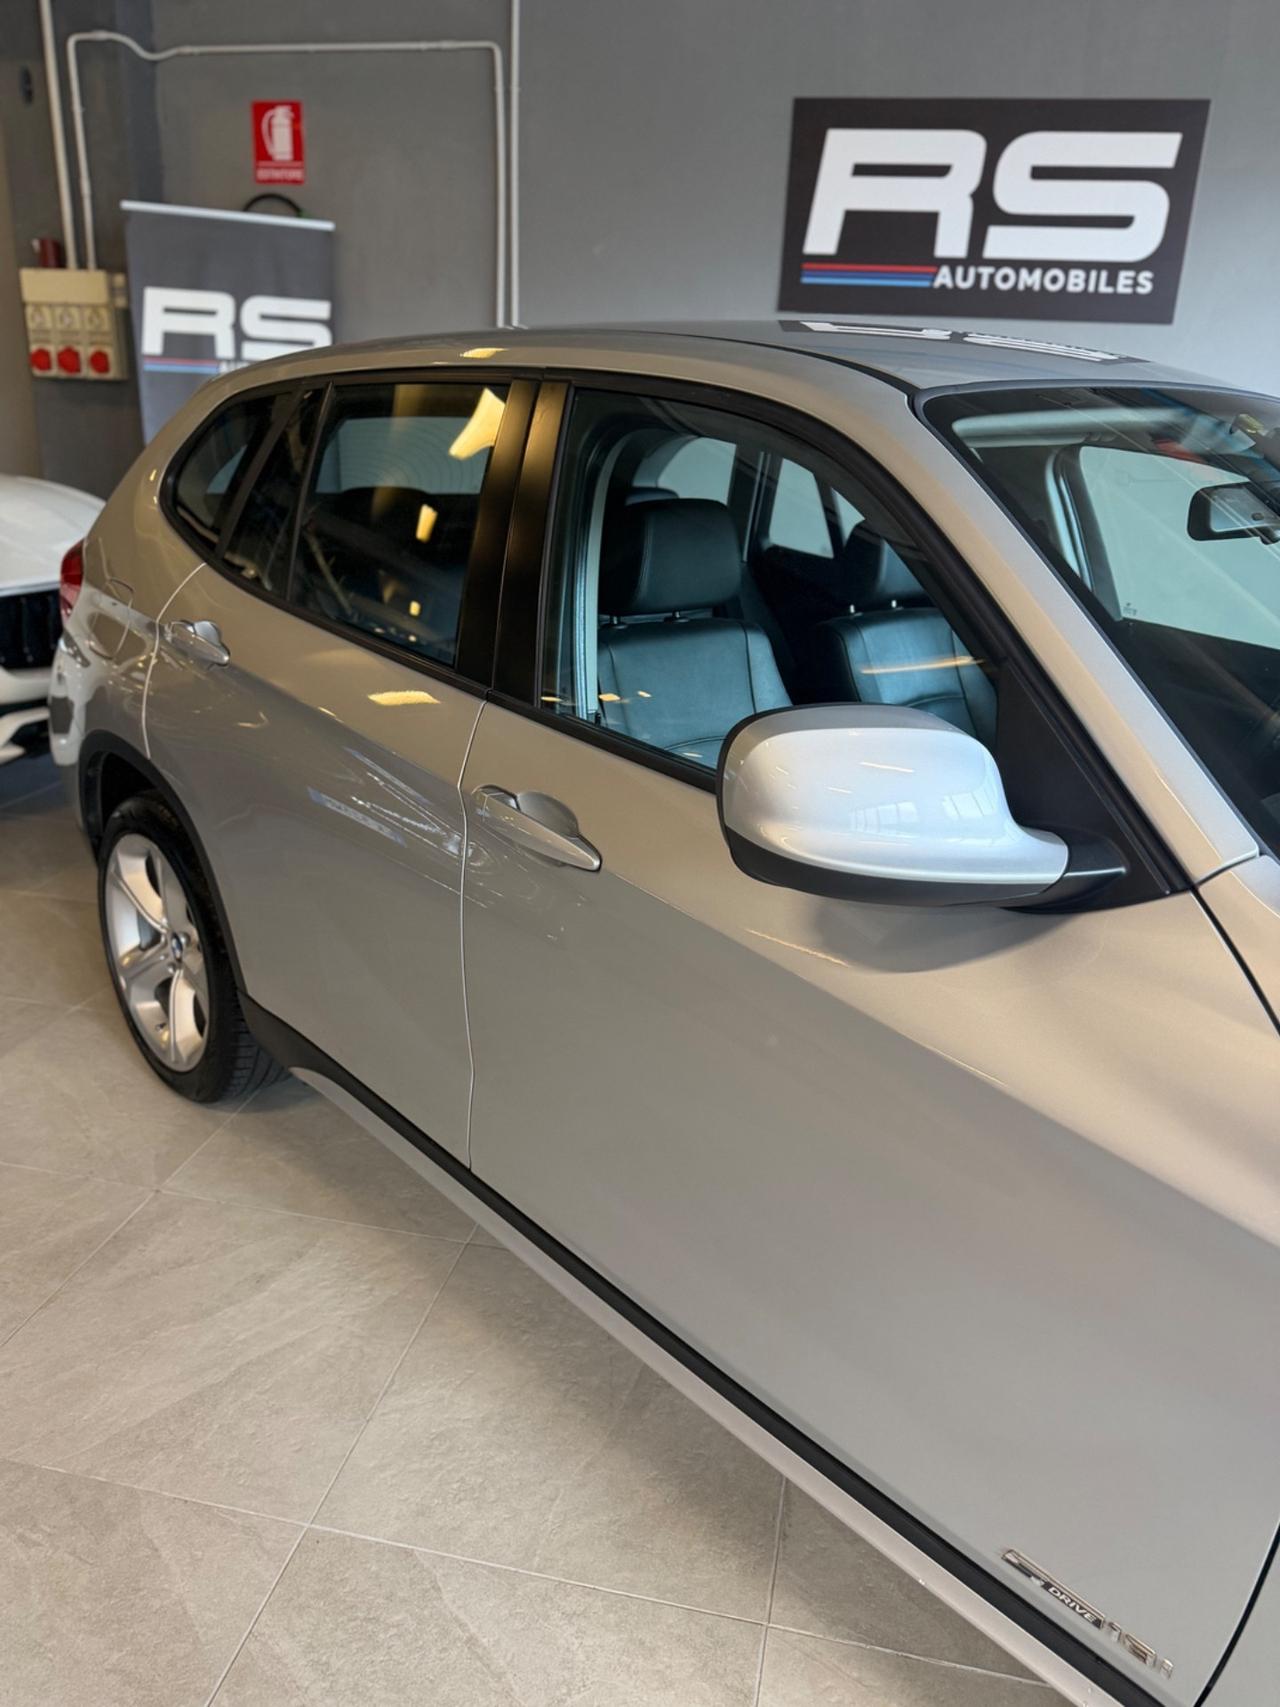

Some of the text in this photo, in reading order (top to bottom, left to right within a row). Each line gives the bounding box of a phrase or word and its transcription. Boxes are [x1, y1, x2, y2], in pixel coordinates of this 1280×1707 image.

[803, 128, 1183, 262] RS
[933, 266, 1154, 295] AUTOMOBILES
[141, 286, 333, 361] RS
